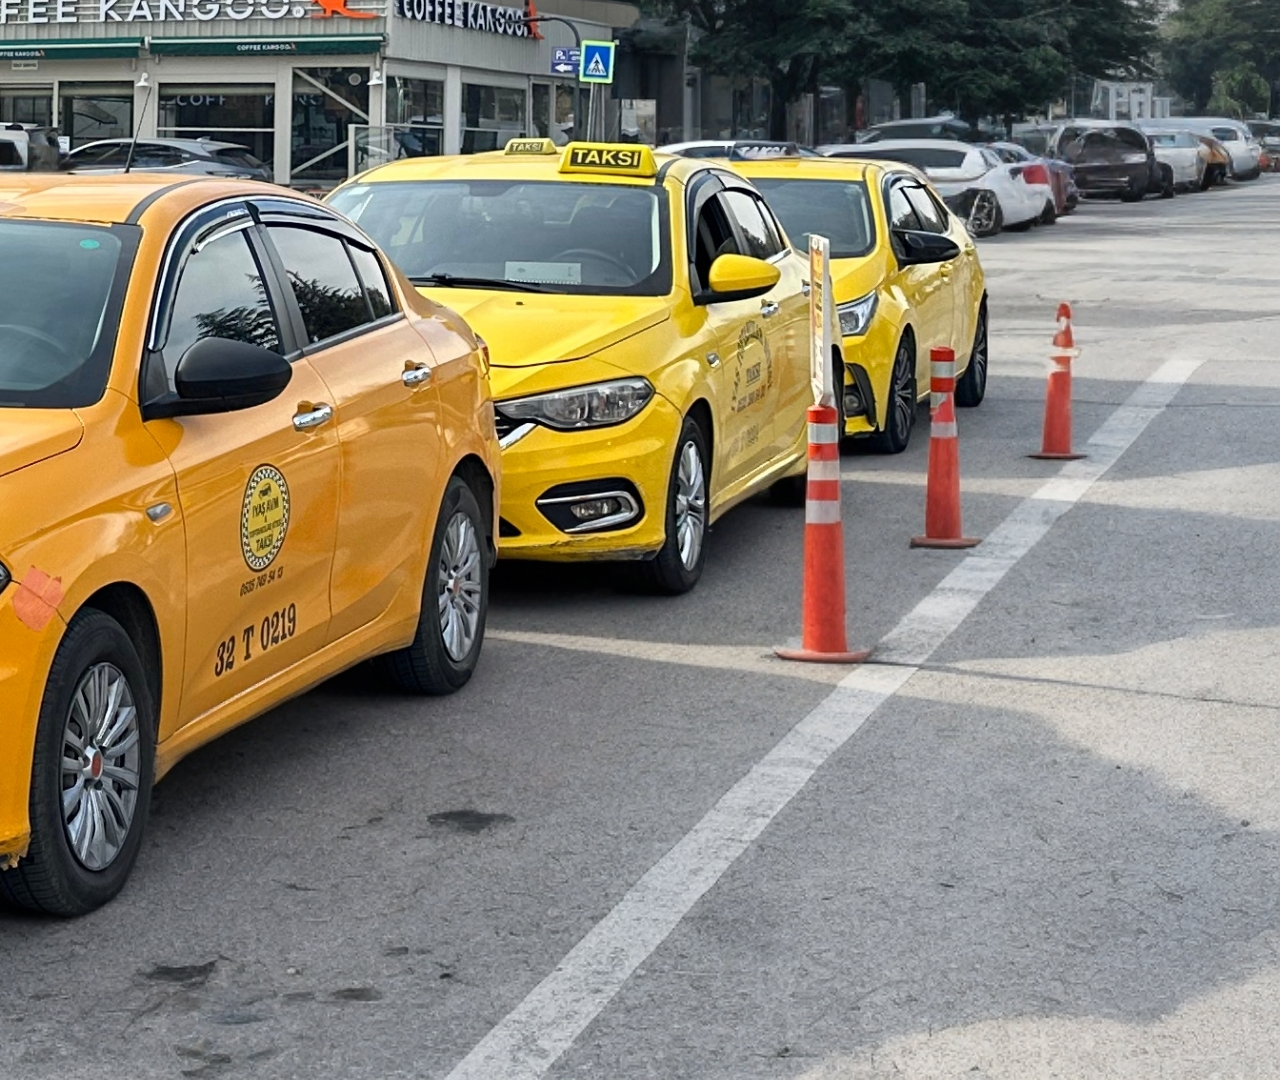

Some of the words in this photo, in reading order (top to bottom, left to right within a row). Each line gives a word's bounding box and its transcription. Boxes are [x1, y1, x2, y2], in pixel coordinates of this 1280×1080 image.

[214, 635, 236, 677] 32
[242, 624, 255, 661] T
[260, 603, 297, 651] 0219
